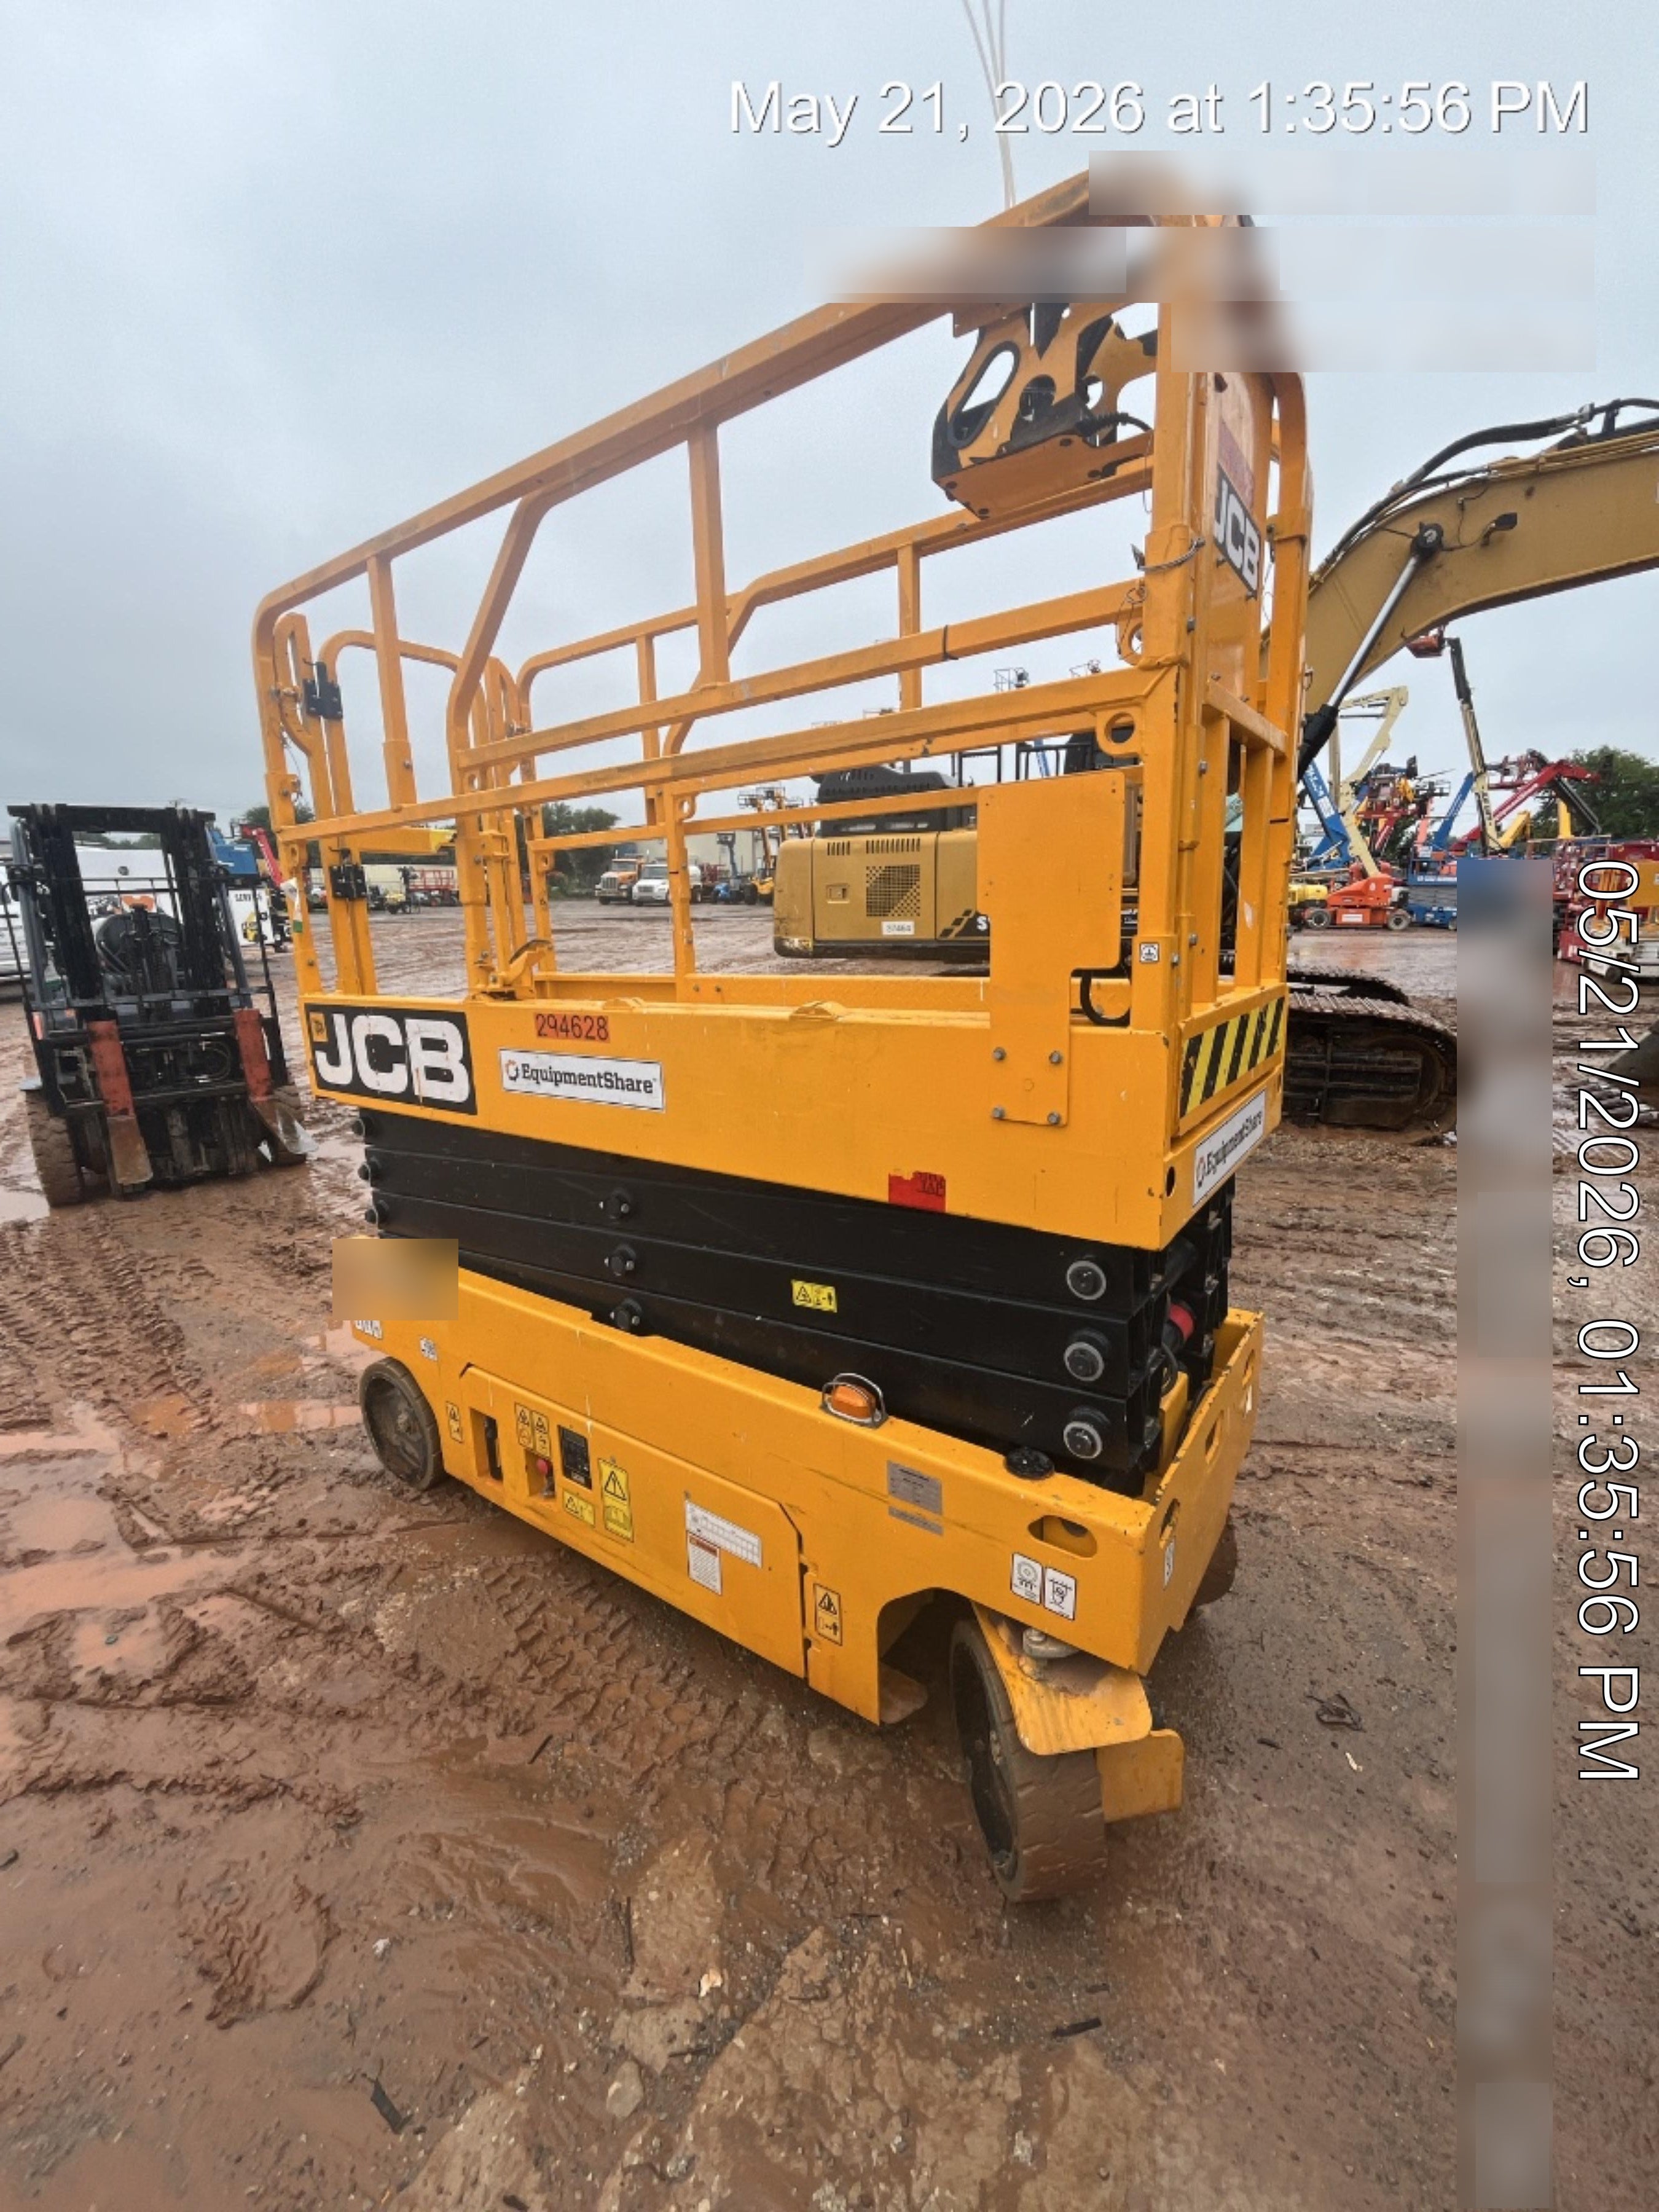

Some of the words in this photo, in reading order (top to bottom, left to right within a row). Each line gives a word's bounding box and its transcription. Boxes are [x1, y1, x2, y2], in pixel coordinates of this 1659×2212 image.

[1214, 478, 1260, 590] JCB
[535, 1014, 610, 1040] 294628
[315, 1013, 470, 1103] JCB
[522, 1063, 654, 1094] EquipmentShare
